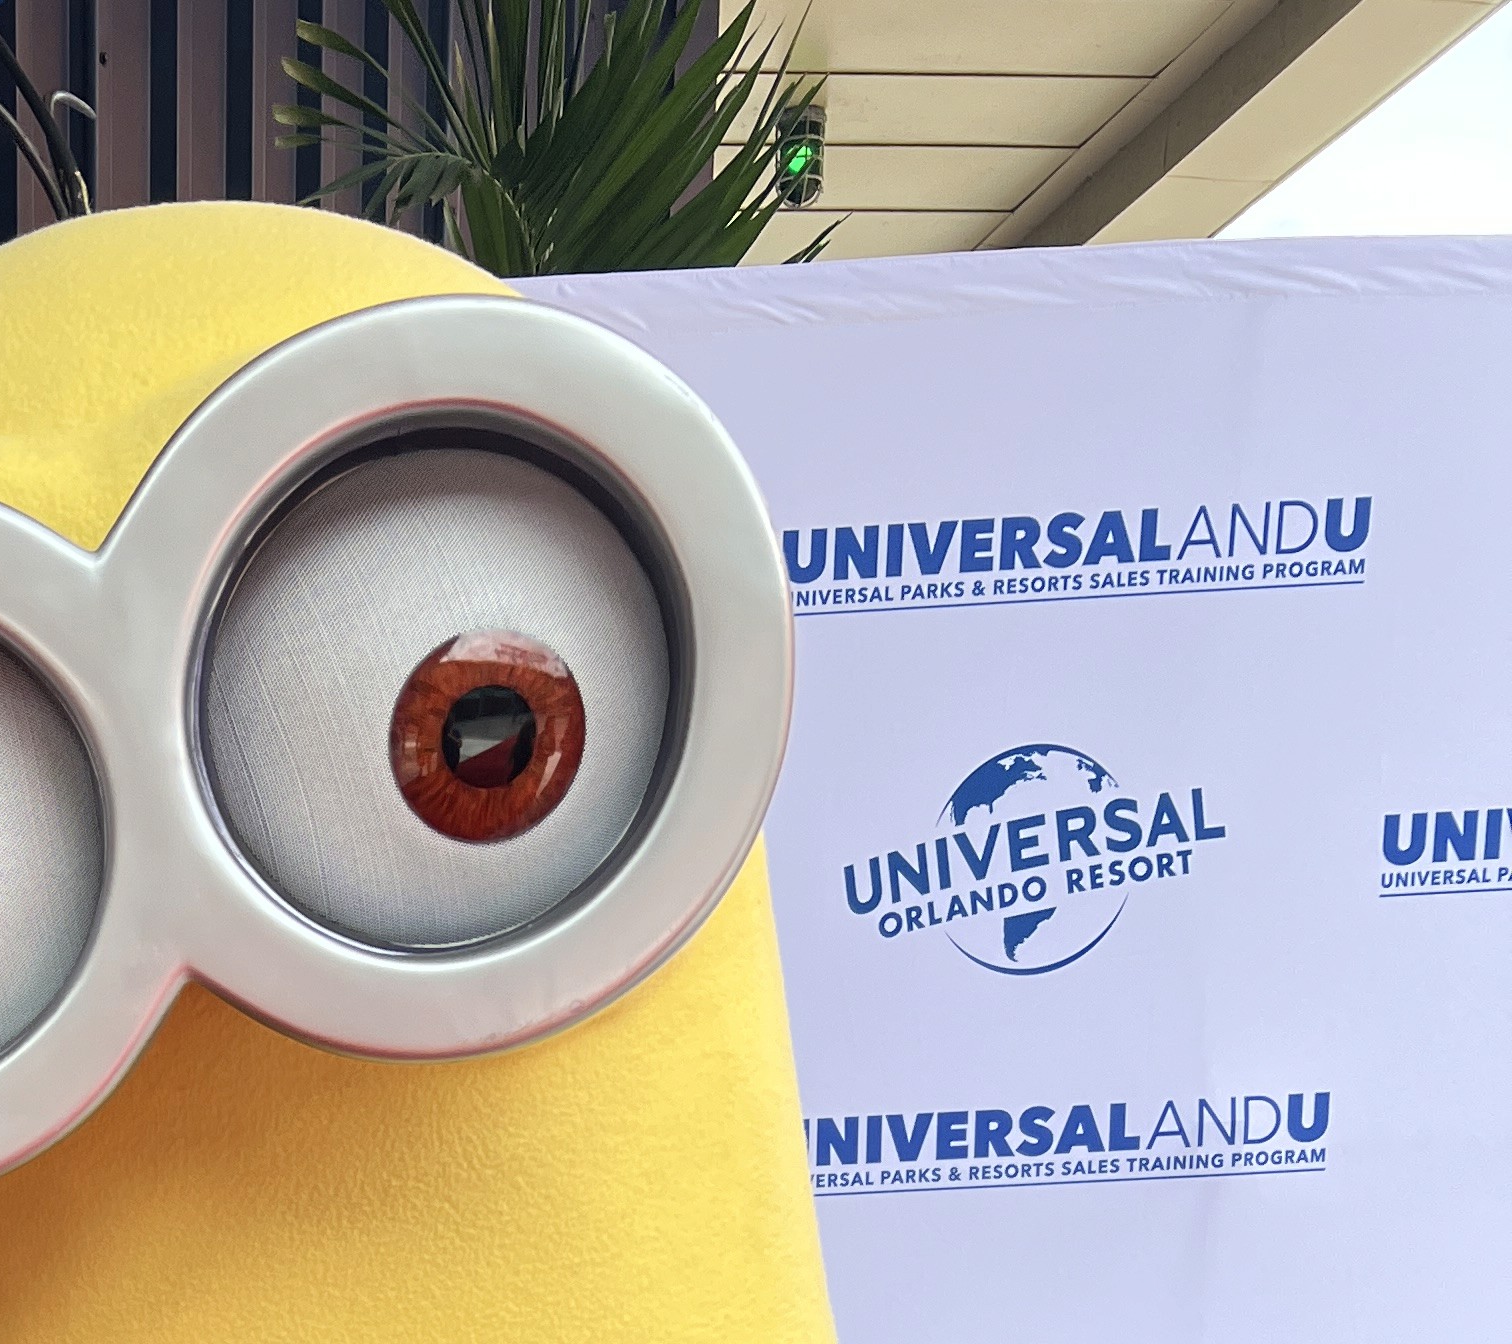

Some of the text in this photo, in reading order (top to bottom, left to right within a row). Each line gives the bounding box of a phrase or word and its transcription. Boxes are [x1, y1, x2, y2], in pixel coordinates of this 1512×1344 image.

[791, 559, 1366, 607] NIVERSAL PARKS & RESORTS SALES TRAINING PROGRAM
[843, 787, 1227, 915] UNIVERSAL
[1382, 807, 1512, 866] UNI
[878, 849, 1193, 938] ORLANDO RESORT
[1381, 867, 1491, 888] UNIVERSAL
[880, 1167, 941, 1185] PARKS
[948, 1166, 962, 1182] &
[968, 1161, 1055, 1181] RESORTS
[1061, 1157, 1120, 1176] SALES
[1126, 1152, 1224, 1173] TRAINING
[1231, 1147, 1326, 1168] PROGRAM
